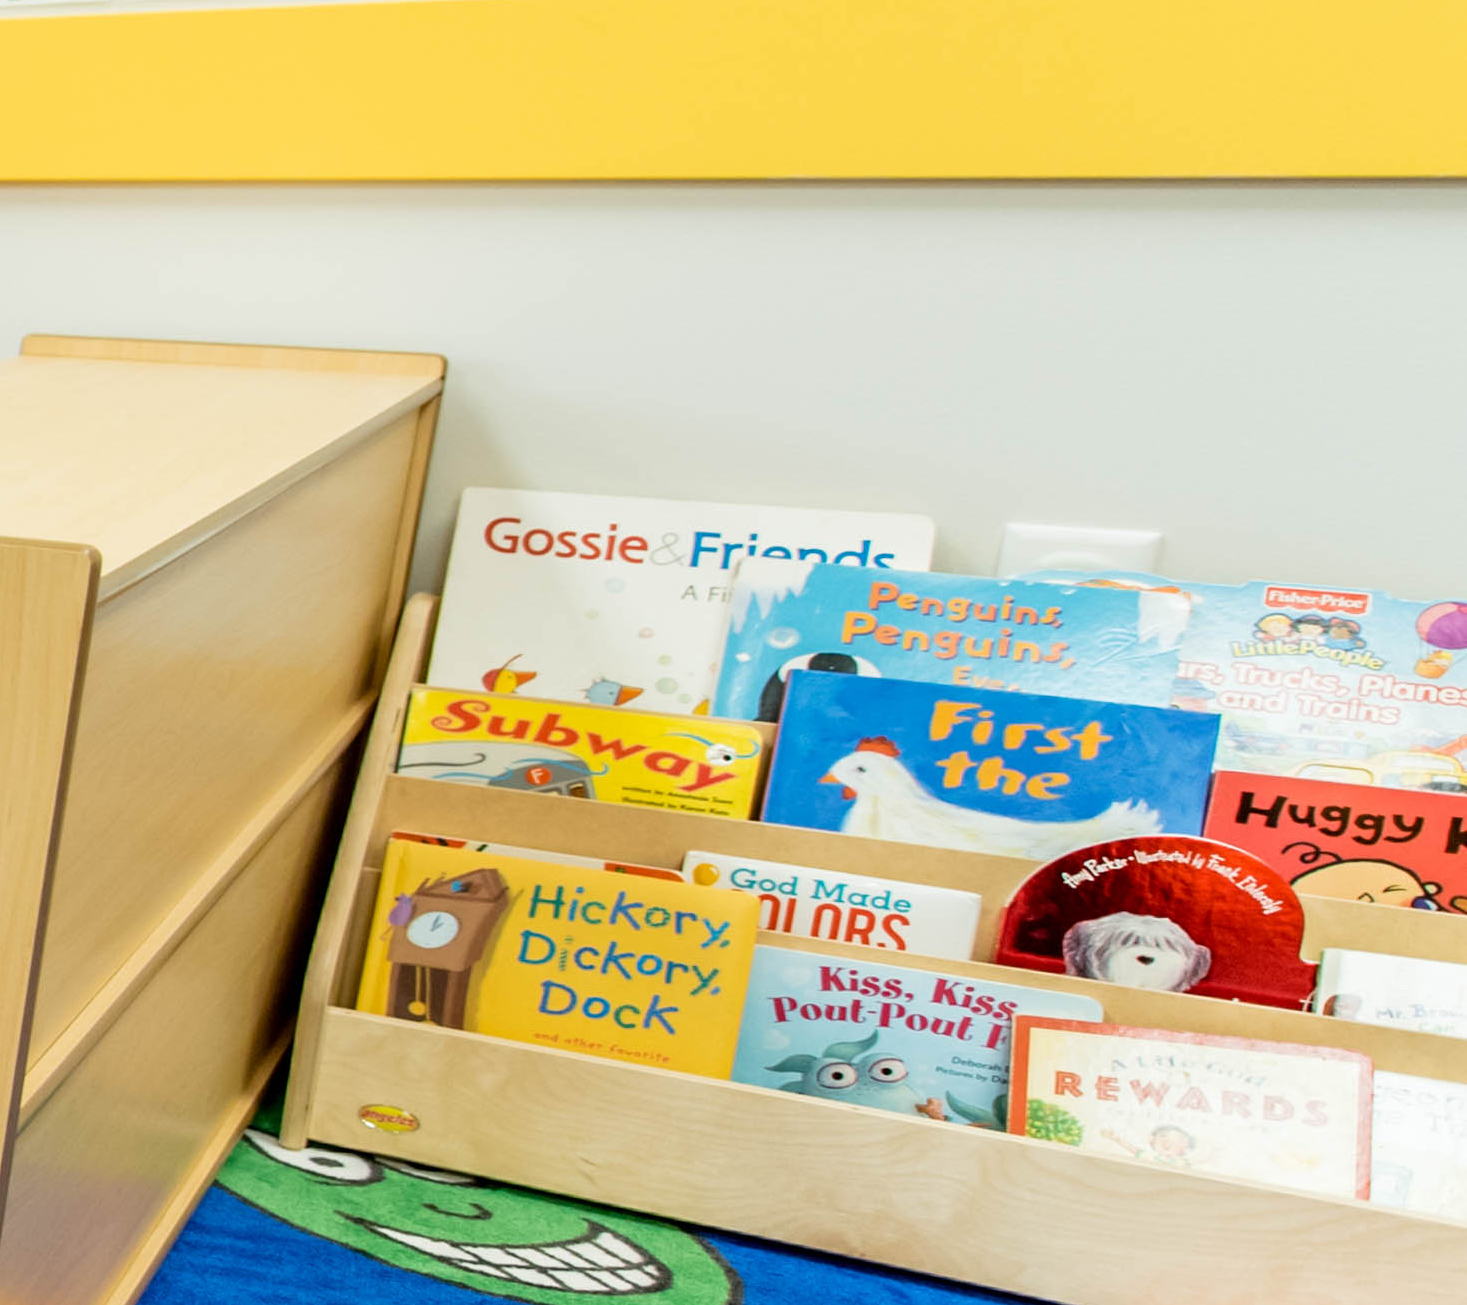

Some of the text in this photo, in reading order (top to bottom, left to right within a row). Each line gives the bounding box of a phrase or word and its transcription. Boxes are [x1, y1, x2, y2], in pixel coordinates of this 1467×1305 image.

[483, 517, 649, 564] Gossie
[649, 532, 684, 567] &
[680, 584, 698, 600] A
[868, 581, 1063, 629] Penguins,
[1268, 589, 1364, 609] Fisher-Price
[842, 611, 1076, 669] Penguins,
[1218, 689, 1402, 725] and Trains
[1231, 661, 1350, 697] Trucks,
[1359, 674, 1467, 707] Plane
[431, 700, 738, 792] Subway
[929, 699, 1112, 761] First
[532, 769, 546, 786] F
[935, 750, 1070, 800] the
[1235, 791, 1425, 846] Huggy
[730, 868, 912, 914] God Made
[528, 884, 731, 949] Hickory,
[518, 929, 722, 997] Dickory,
[538, 979, 677, 1035] Dock
[818, 965, 1018, 1021] Kiss, Kiss
[767, 996, 975, 1042] Pout-Pout
[533, 1032, 671, 1063] and other favorite
[951, 1055, 1002, 1072] Deborah
[935, 1065, 974, 1079] Pictures
[975, 1073, 988, 1083] by
[1054, 1068, 1330, 1127] REWARDS
